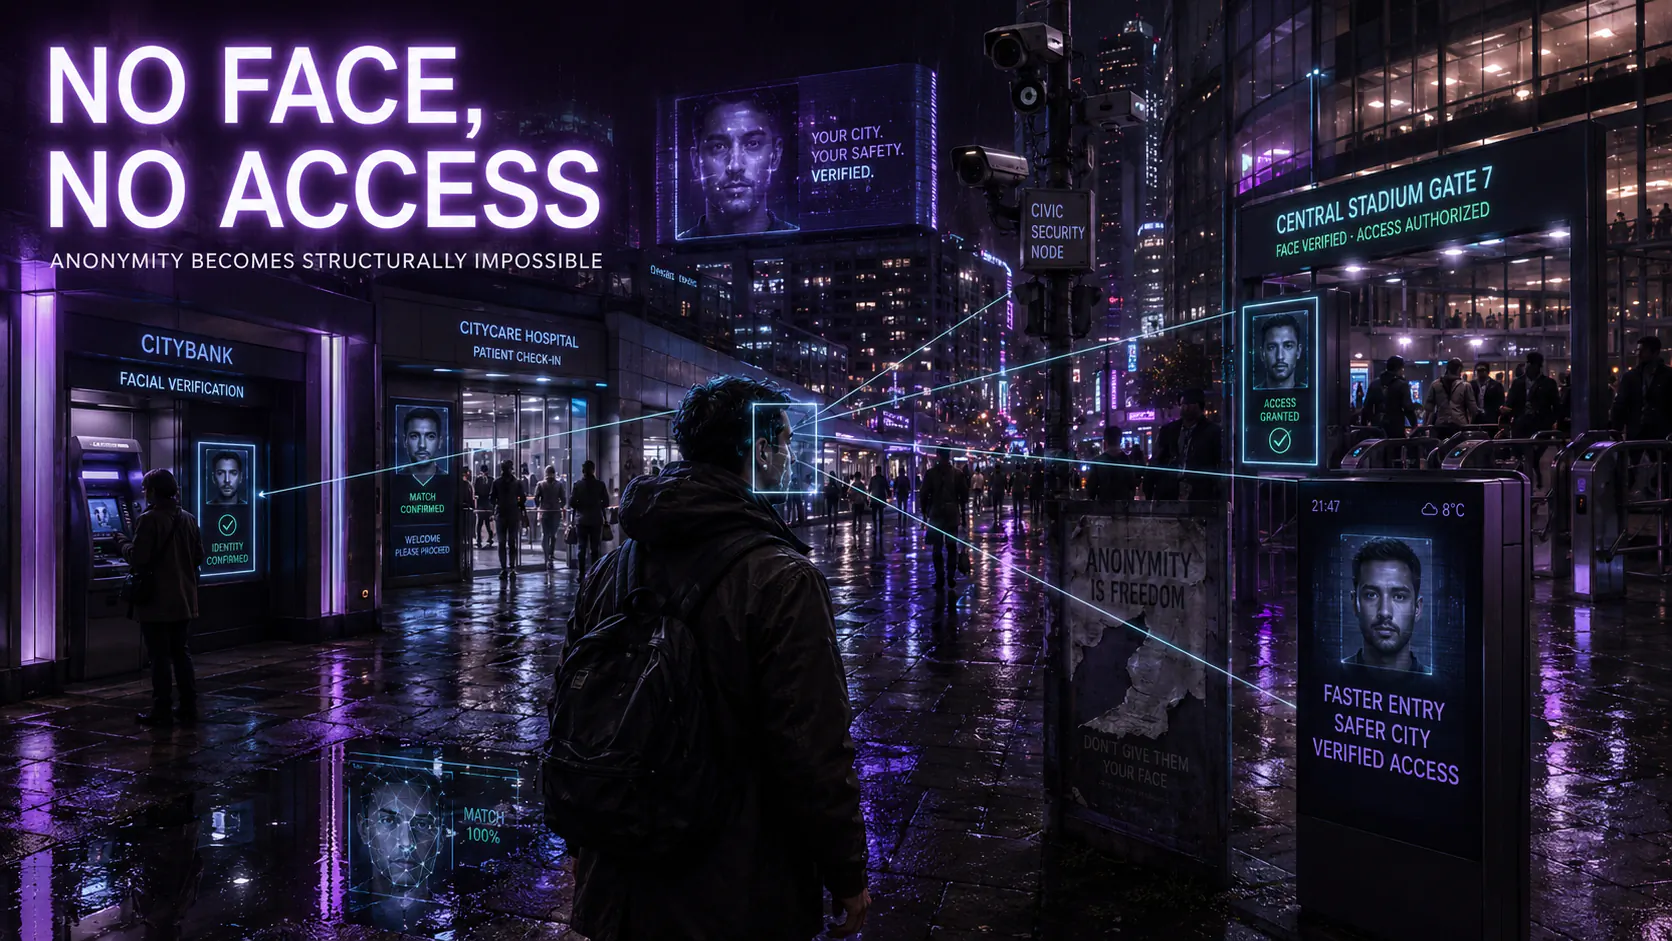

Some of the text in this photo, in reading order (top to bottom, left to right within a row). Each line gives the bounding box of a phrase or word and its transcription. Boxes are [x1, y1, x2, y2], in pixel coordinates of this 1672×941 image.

[812, 126, 884, 144] YOUR CITY.
[812, 143, 905, 163] YOUR SAFETY.
[812, 166, 875, 183] VERIFIED.
[1277, 165, 1494, 234] CENTRAL STADIUM GATE 7
[1032, 203, 1063, 218] CIVIC
[1032, 225, 1084, 239] SECURITY
[1276, 242, 1300, 258] FACE
[1303, 231, 1346, 251] VERIFIED
[1357, 220, 1401, 241] ACCESS
[1405, 201, 1490, 232] AUTHORIZED
[1032, 245, 1063, 258] NODE
[460, 321, 578, 348] CITYCARE HOSPITAL
[142, 334, 232, 364] CITYBANK
[474, 346, 560, 365] PATIENT CHECK-IN
[120, 371, 244, 398] FACIAL VERIFICATION
[1264, 398, 1296, 408] ACCESS
[1261, 412, 1299, 421] GRANTED
[409, 492, 436, 501] MATCH
[1312, 500, 1340, 512] 21:47
[1443, 503, 1464, 517] 8°C
[404, 534, 441, 545] WELCOME
[395, 548, 419, 557] PLEASE
[1086, 547, 1193, 579] ANONYMITY
[1090, 579, 1185, 610] IS FREEDOM
[1325, 684, 1444, 721] FASTER ENTRY
[1335, 714, 1430, 748] SAFER CITY
[1085, 733, 1188, 774] DON'T GIVE THEM
[1313, 737, 1459, 785] VERIFIED ACCESS
[1103, 760, 1167, 788] YOUR FACE
[463, 806, 504, 825] MATCH
[467, 826, 501, 844] 100%
